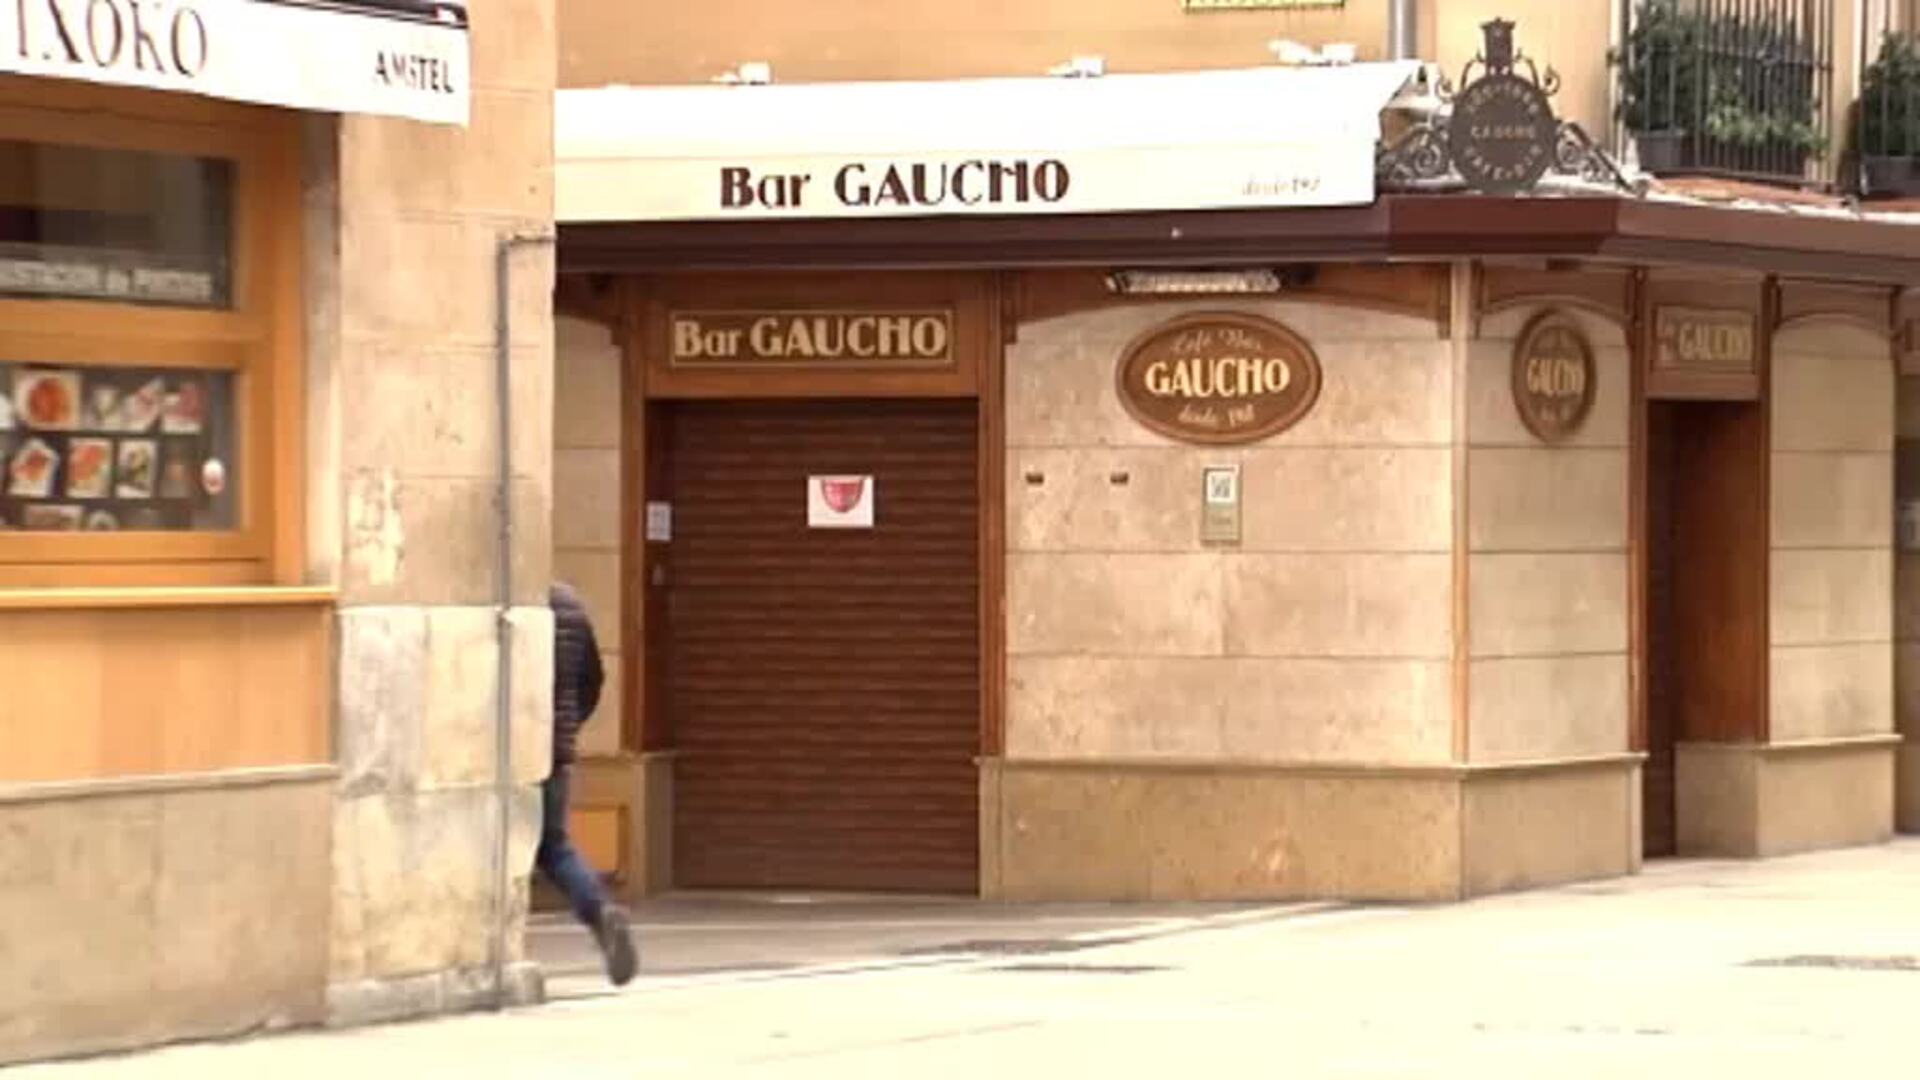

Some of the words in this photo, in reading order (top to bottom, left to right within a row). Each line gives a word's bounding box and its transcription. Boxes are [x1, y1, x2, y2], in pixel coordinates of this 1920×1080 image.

[376, 51, 455, 94] AMSTEL
[720, 167, 811, 209] Bar
[834, 159, 1070, 206] GAUCHO
[674, 320, 742, 357] Bar
[750, 316, 948, 357] GAUCHO
[1145, 357, 1290, 397] GAUCHO
